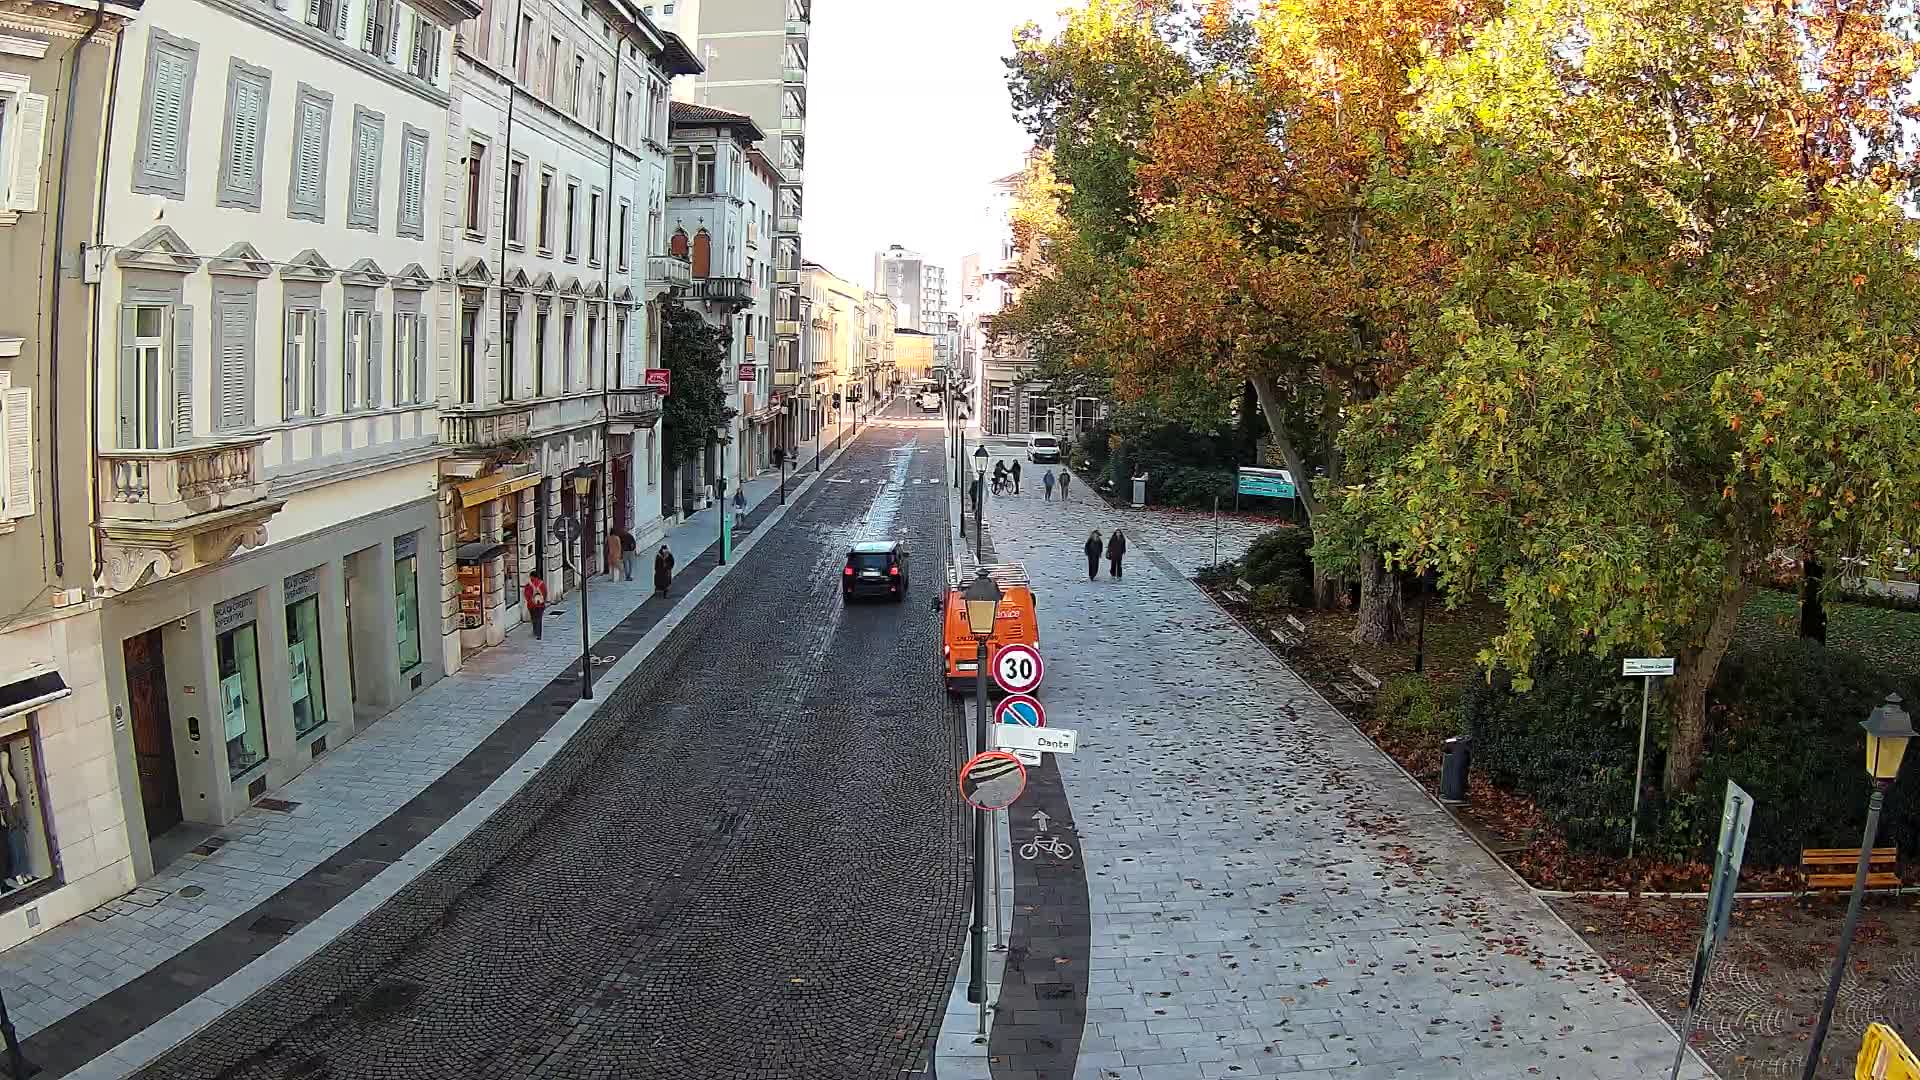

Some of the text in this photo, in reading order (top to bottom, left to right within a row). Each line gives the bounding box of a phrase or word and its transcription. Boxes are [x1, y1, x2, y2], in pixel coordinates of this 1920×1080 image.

[995, 610, 1021, 619] ervice
[1005, 658, 1033, 680] 30
[1037, 737, 1069, 748] Dante
